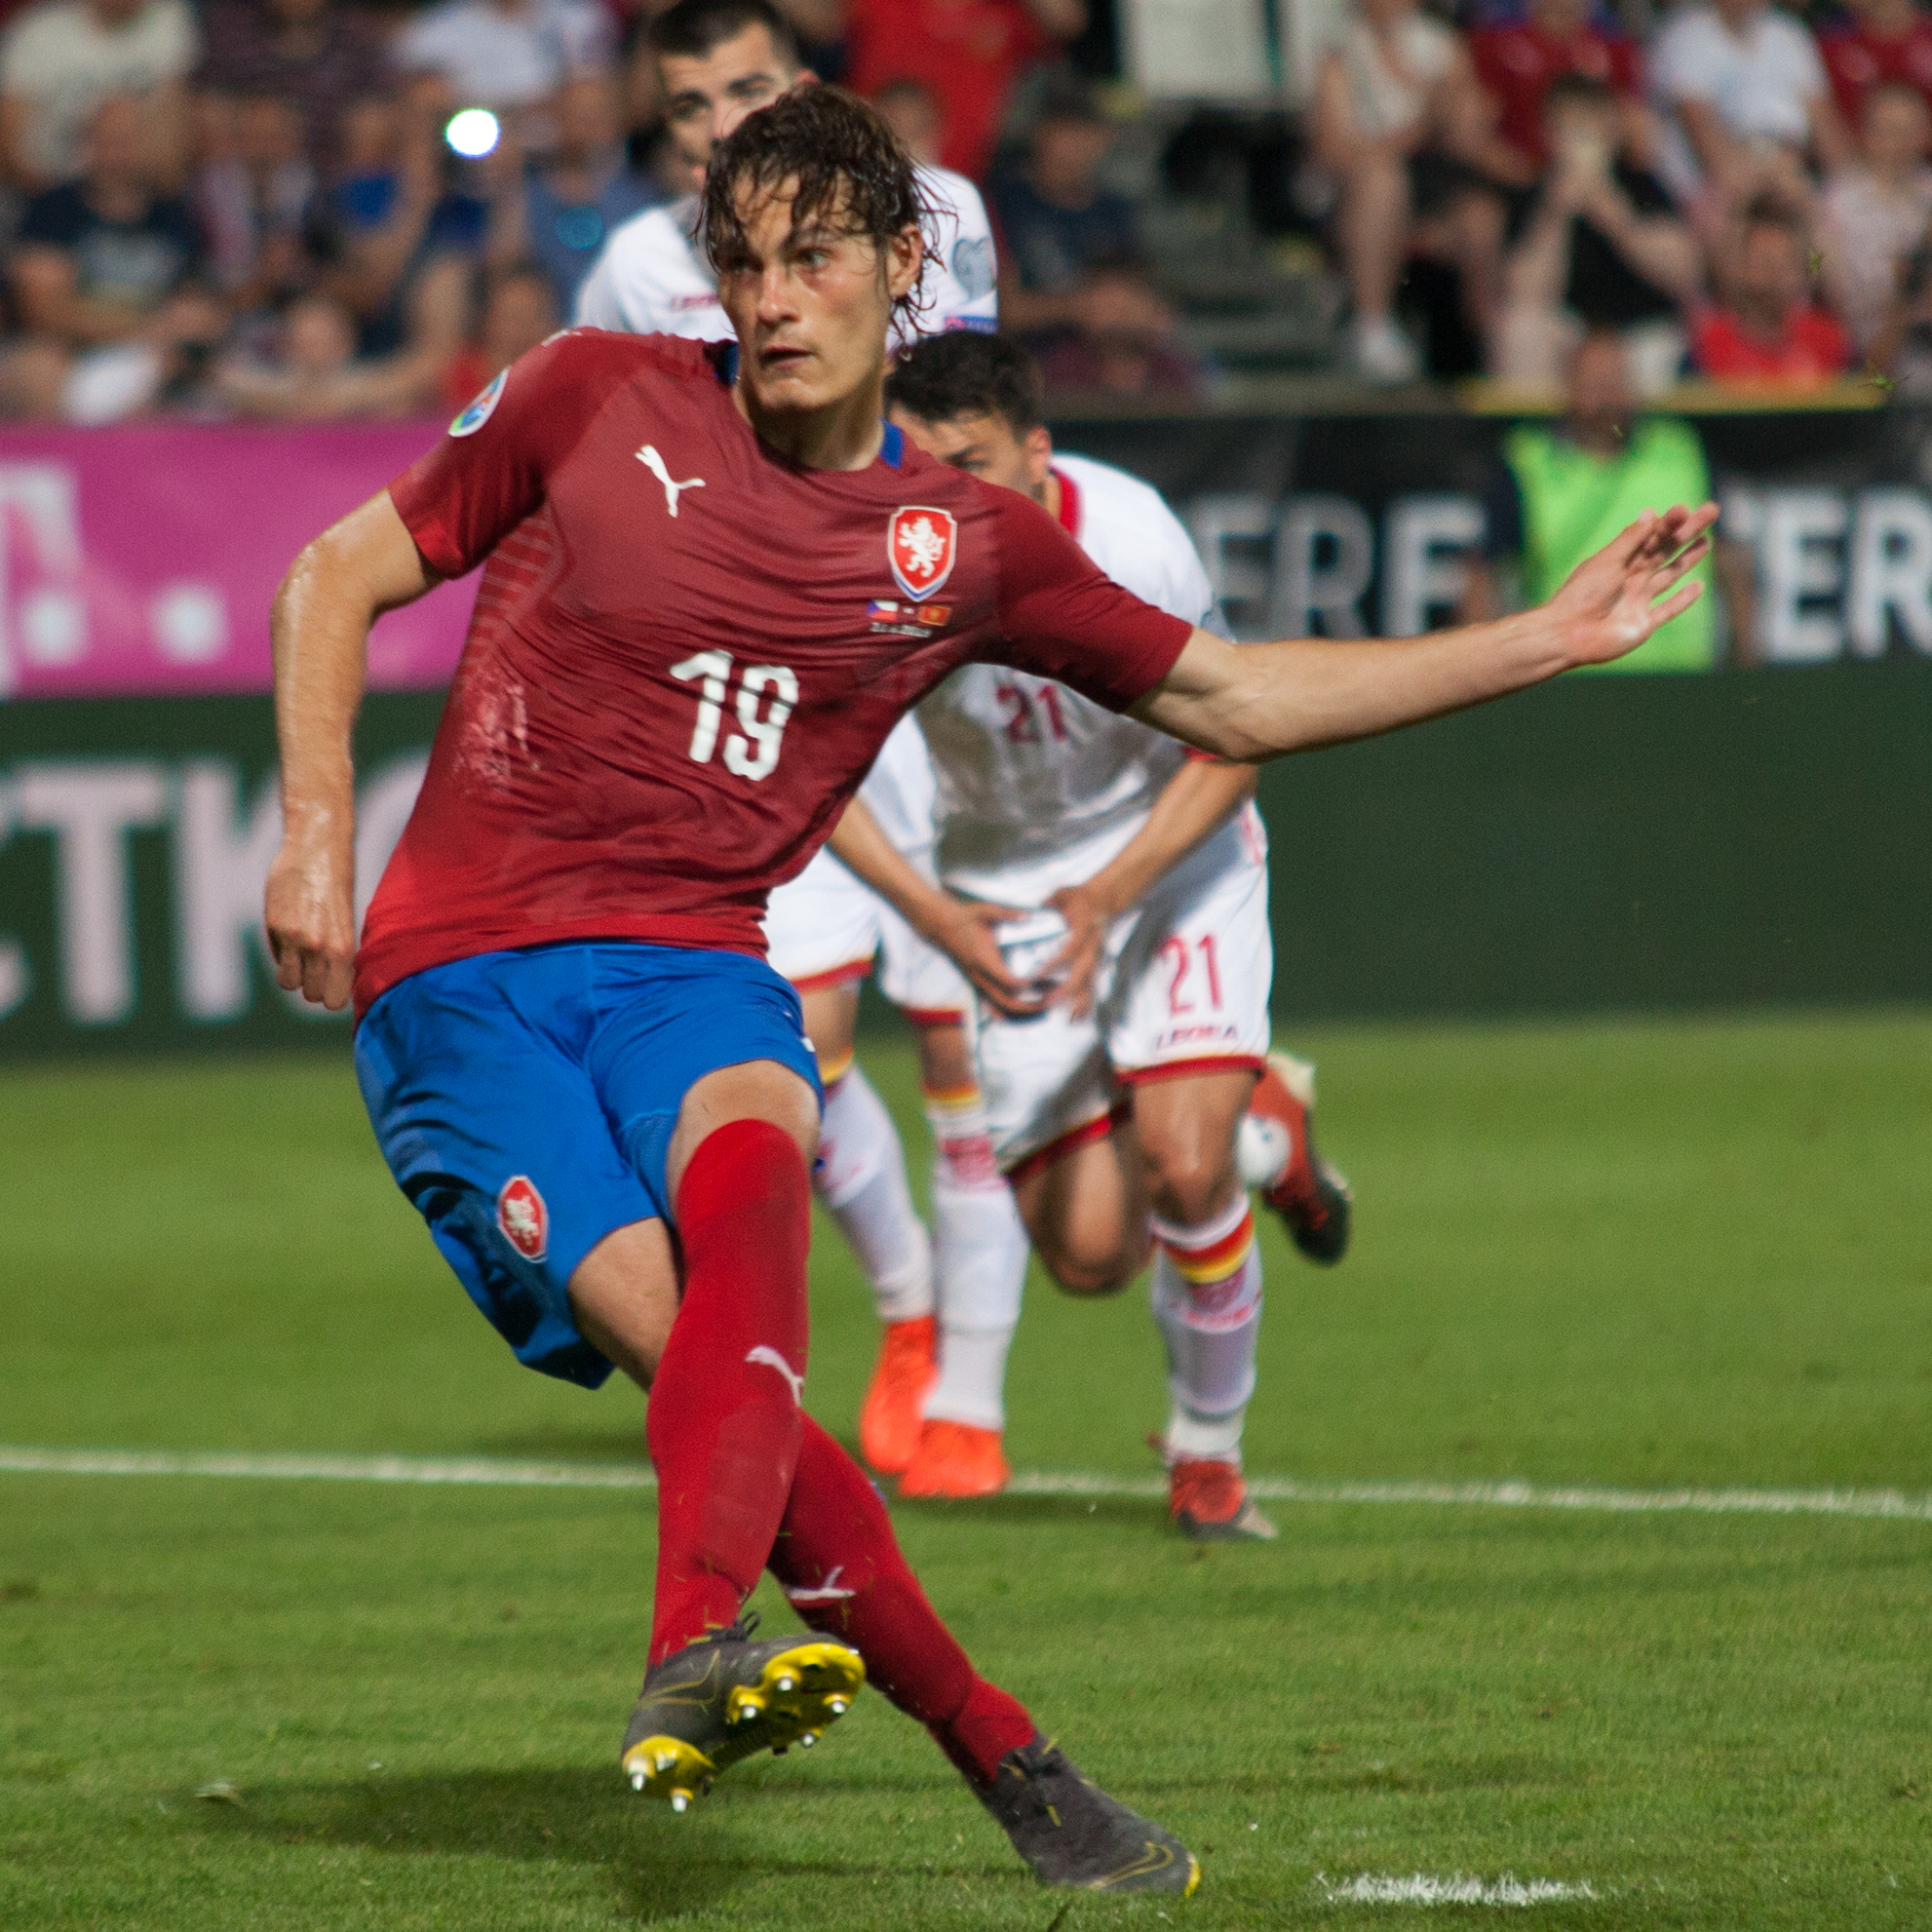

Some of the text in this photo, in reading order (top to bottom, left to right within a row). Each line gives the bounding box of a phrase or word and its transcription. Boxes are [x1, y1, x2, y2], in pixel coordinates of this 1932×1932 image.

[669, 649, 799, 781] 19
[996, 683, 1067, 743] 21
[1160, 933, 1223, 1016] 21
